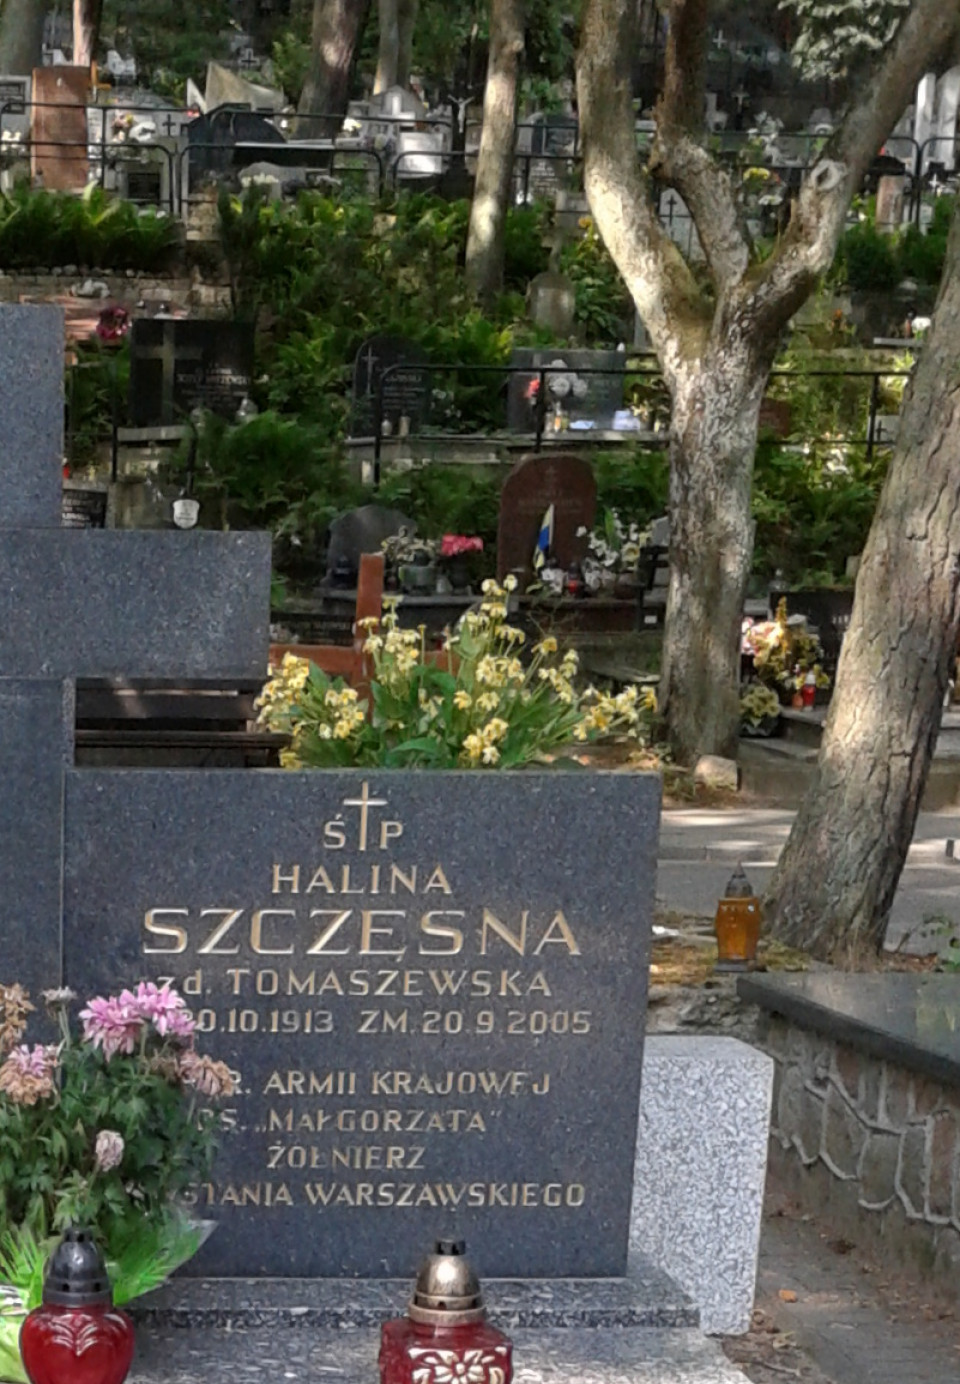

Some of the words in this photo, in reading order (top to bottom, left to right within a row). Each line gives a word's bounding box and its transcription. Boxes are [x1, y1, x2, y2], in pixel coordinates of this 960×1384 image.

[323, 814, 346, 849] Ś
[379, 820, 404, 849] P
[271, 862, 453, 894] HALINA
[142, 906, 582, 962] SZCZĘSNA
[226, 967, 553, 997] TOMASZEWSKA
[263, 1070, 356, 1095] ARMII
[267, 1140, 426, 1170] ŻOŁNIERZ
[304, 1182, 586, 1207] WARSZAWSKIEGO
